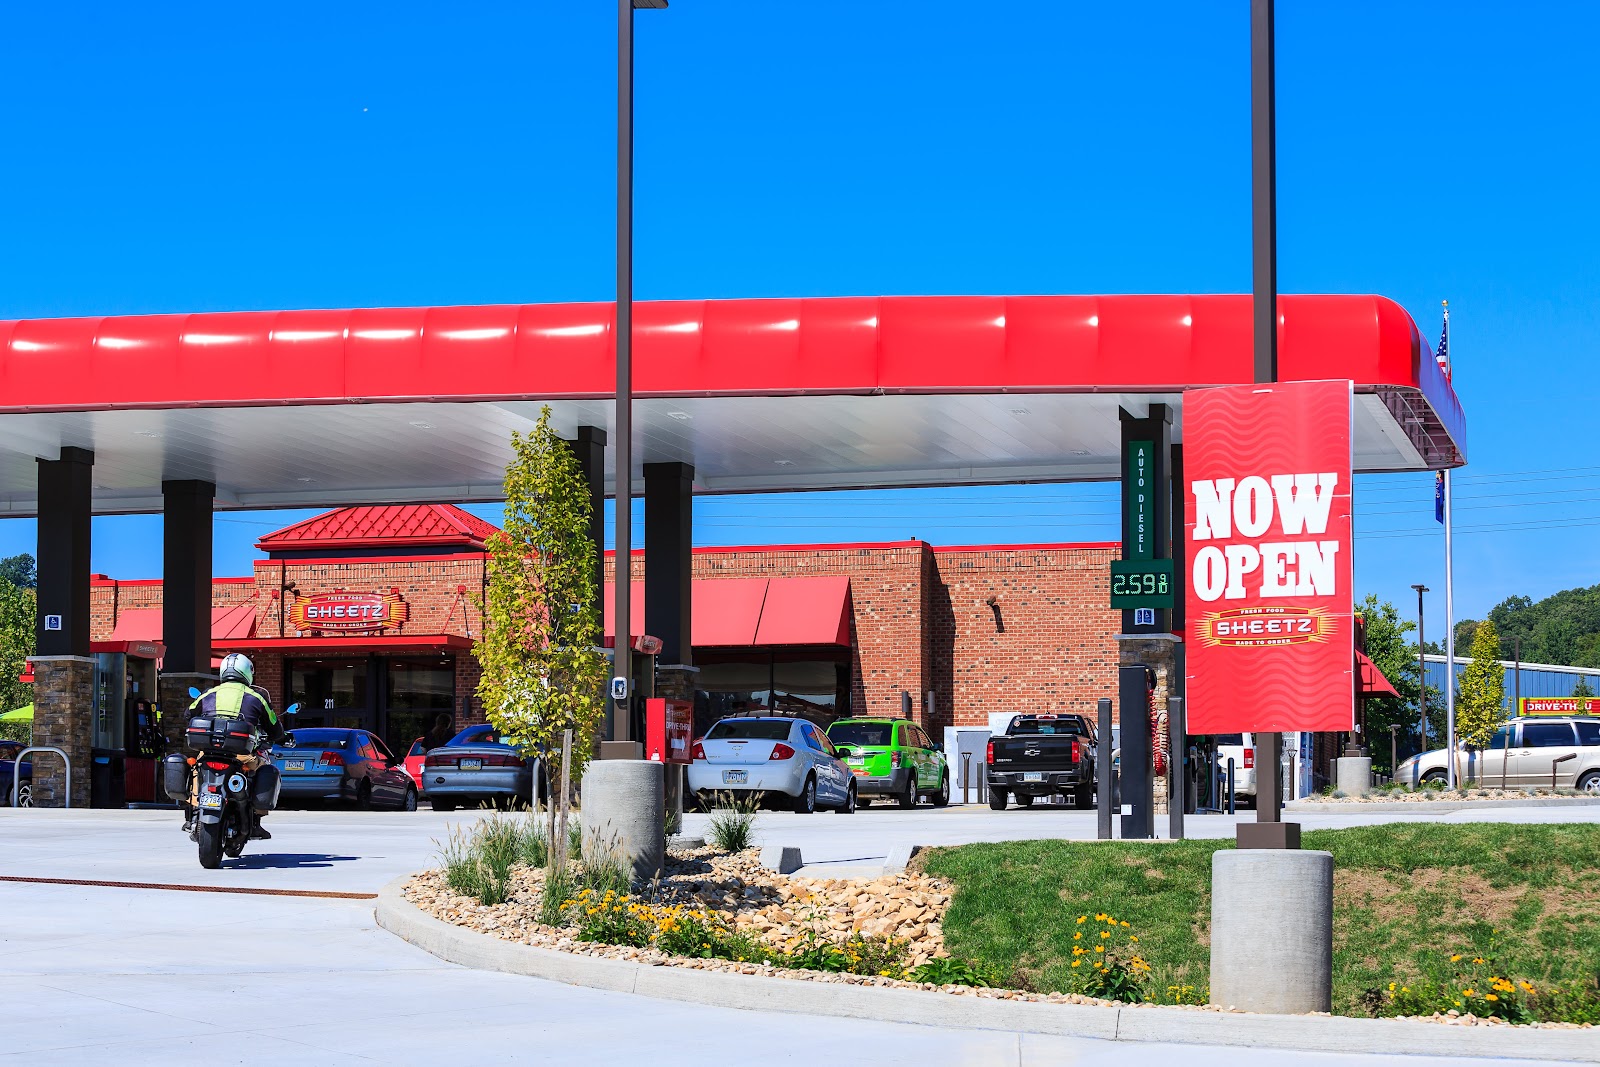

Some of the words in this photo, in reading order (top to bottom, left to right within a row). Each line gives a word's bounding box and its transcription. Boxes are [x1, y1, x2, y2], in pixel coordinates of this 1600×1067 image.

[1191, 472, 1338, 541] NOW
[1192, 540, 1340, 602] OPEN
[307, 604, 384, 618] SHEETZ
[1217, 618, 1313, 635] SHEETZ
[324, 698, 335, 709] 211
[1527, 703, 1592, 711] DRIVE-THU
